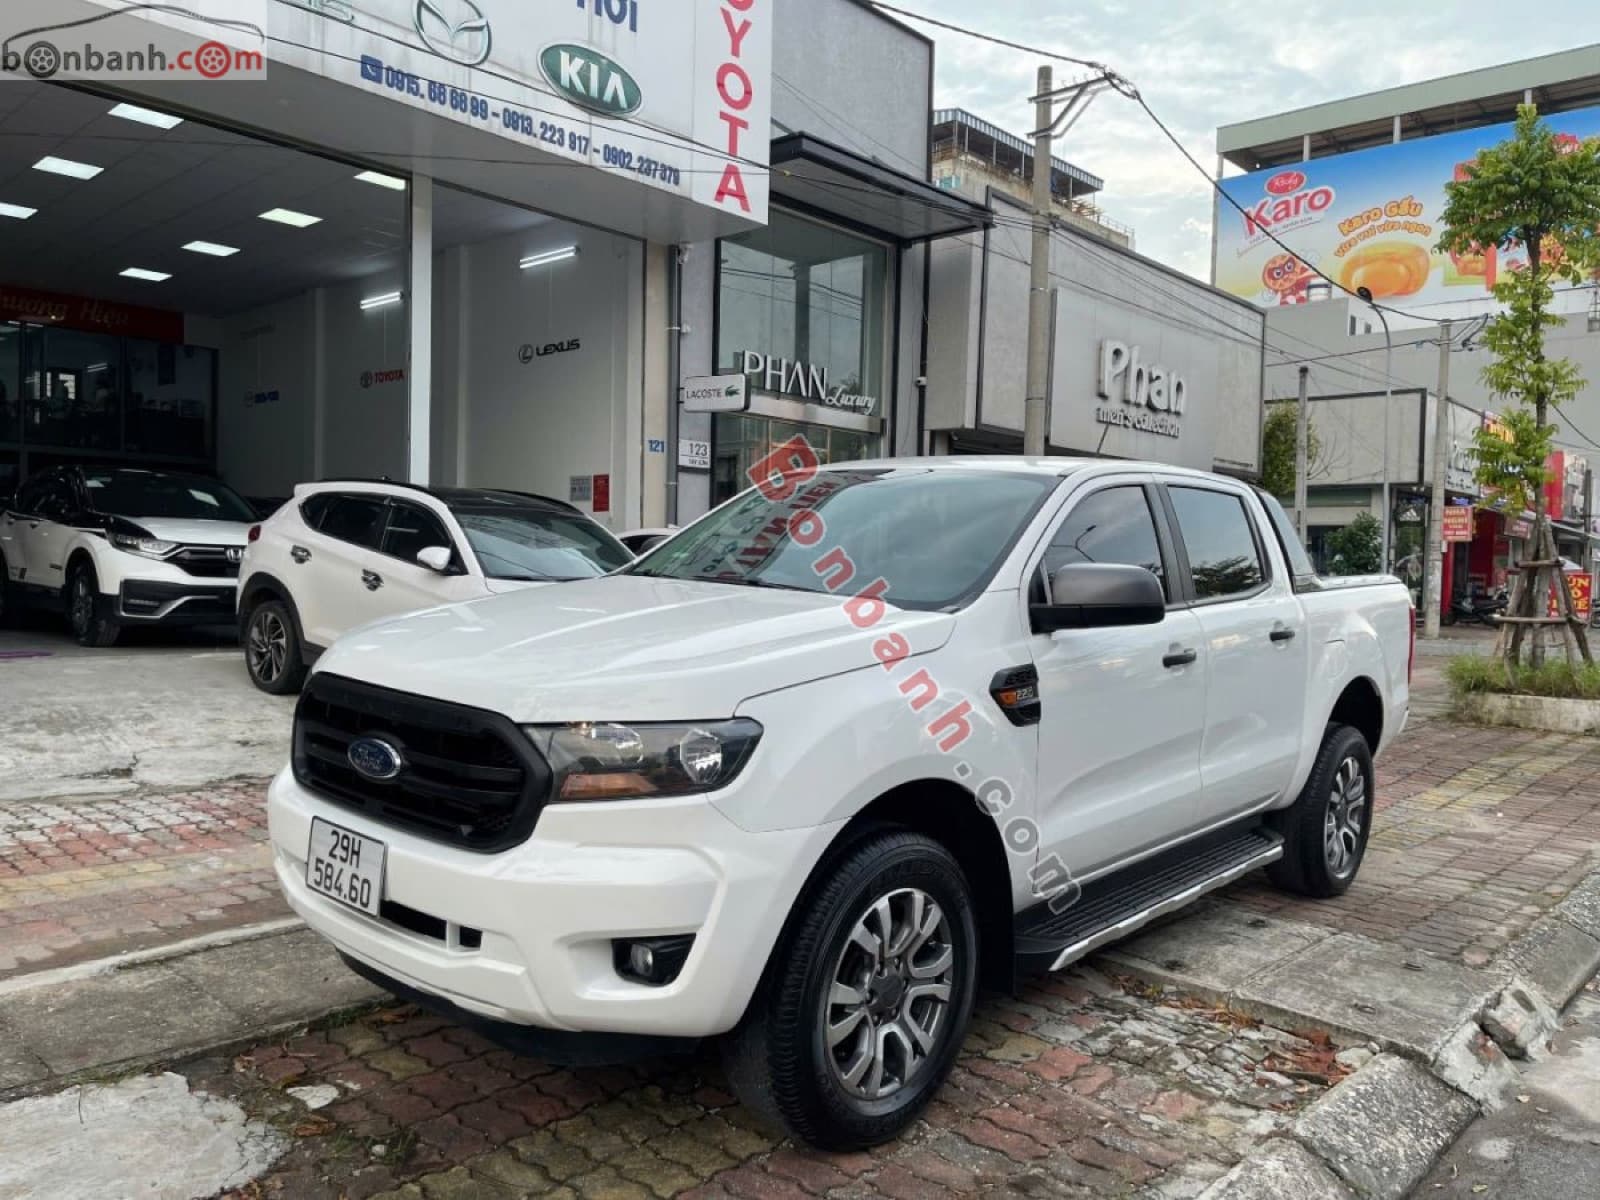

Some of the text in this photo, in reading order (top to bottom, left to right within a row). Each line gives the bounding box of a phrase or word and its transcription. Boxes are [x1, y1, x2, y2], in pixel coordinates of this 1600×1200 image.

[559, 50, 628, 109] KIA
[714, 0, 755, 212] YOTA
[1245, 187, 1333, 236] Karo
[1338, 207, 1382, 236] Karo
[536, 339, 581, 356] LEXUS
[375, 369, 404, 384] TOYOTA
[686, 387, 722, 399] LACOSTE
[743, 350, 828, 400] PHAN
[1099, 338, 1185, 414] Phan
[648, 439, 665, 453] 121
[689, 442, 708, 456] 123
[329, 830, 362, 868] 29H
[313, 856, 371, 908] 584.60
